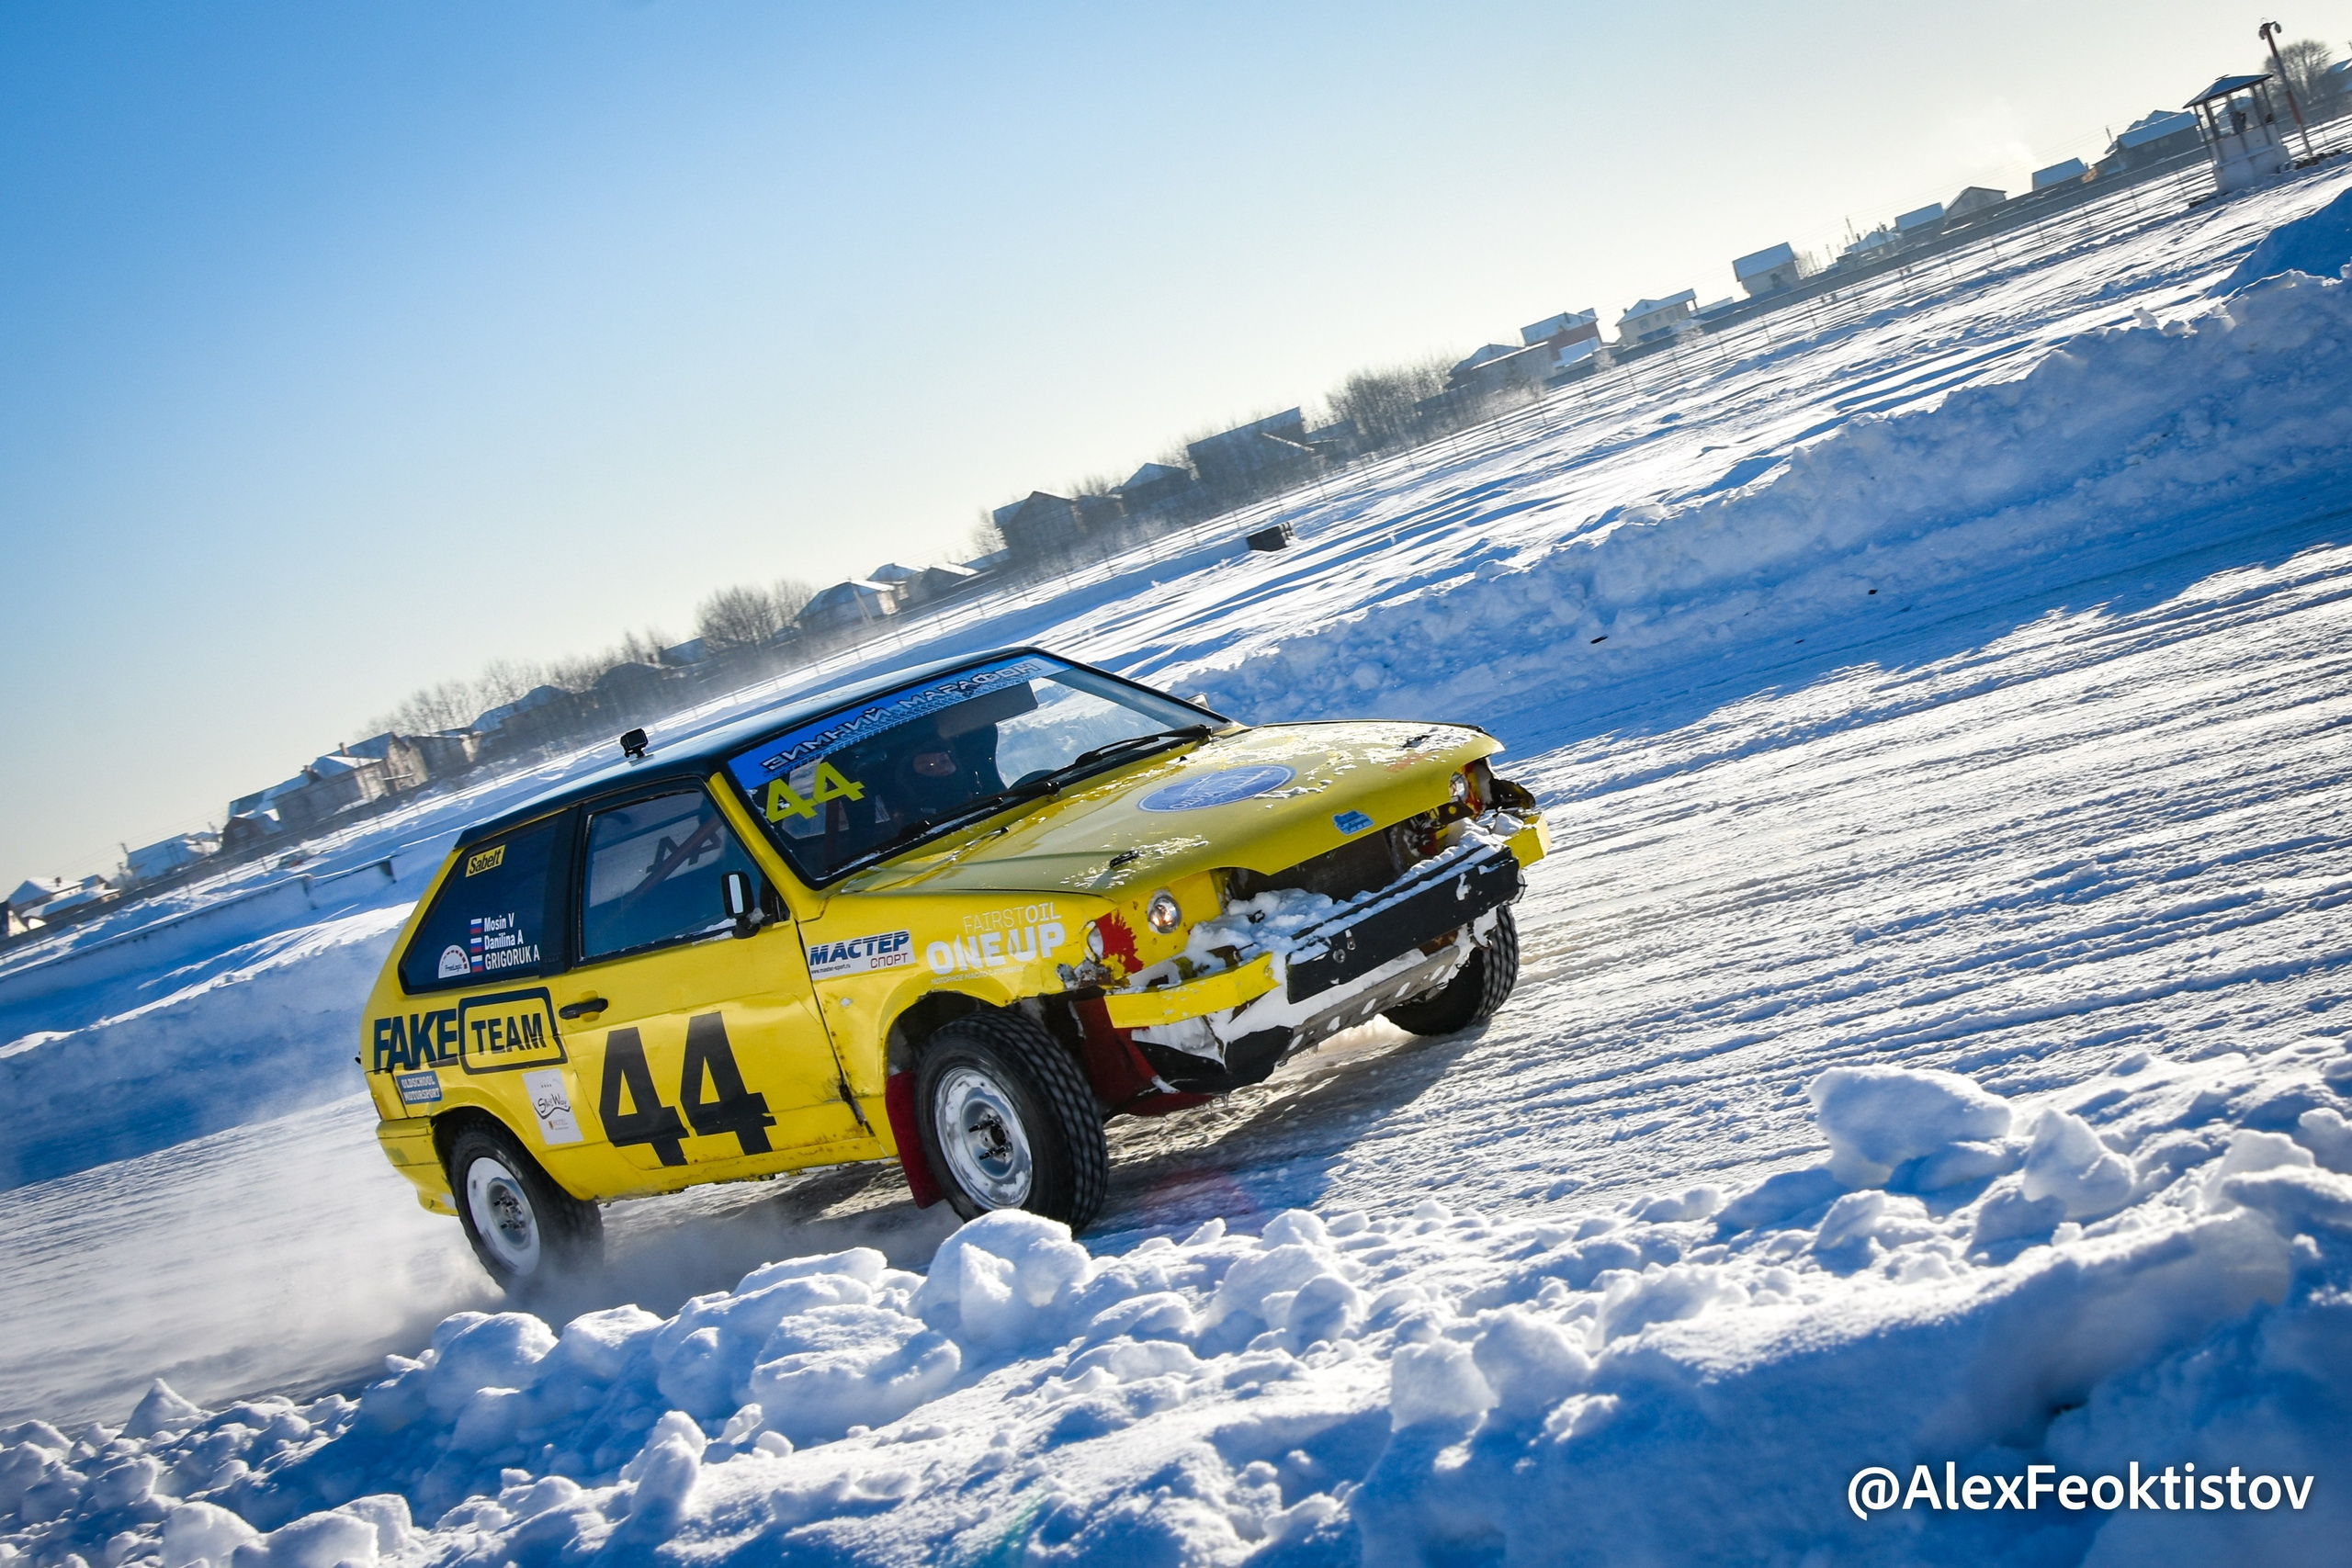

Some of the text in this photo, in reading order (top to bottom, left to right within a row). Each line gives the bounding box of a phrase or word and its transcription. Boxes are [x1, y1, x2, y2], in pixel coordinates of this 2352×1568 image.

[761, 662, 1042, 771] ЗИМНИЙ МАРАФОН
[765, 761, 865, 824] 44
[469, 850, 502, 874] Sabelt
[484, 913, 514, 932] Mosin V
[963, 902, 1062, 933] FAIRSTOIL
[484, 930, 524, 951] Danilina A
[809, 931, 910, 965] МАСТЕР
[485, 945, 532, 970] GRIGORUK
[533, 944, 540, 961] A
[870, 953, 909, 968] СПОРТ
[374, 1009, 547, 1074] FAKE TEAM
[401, 1076, 435, 1089] OLDSCHOOL
[403, 1088, 440, 1101] MOTORSPORT
[598, 1010, 776, 1167] 44
